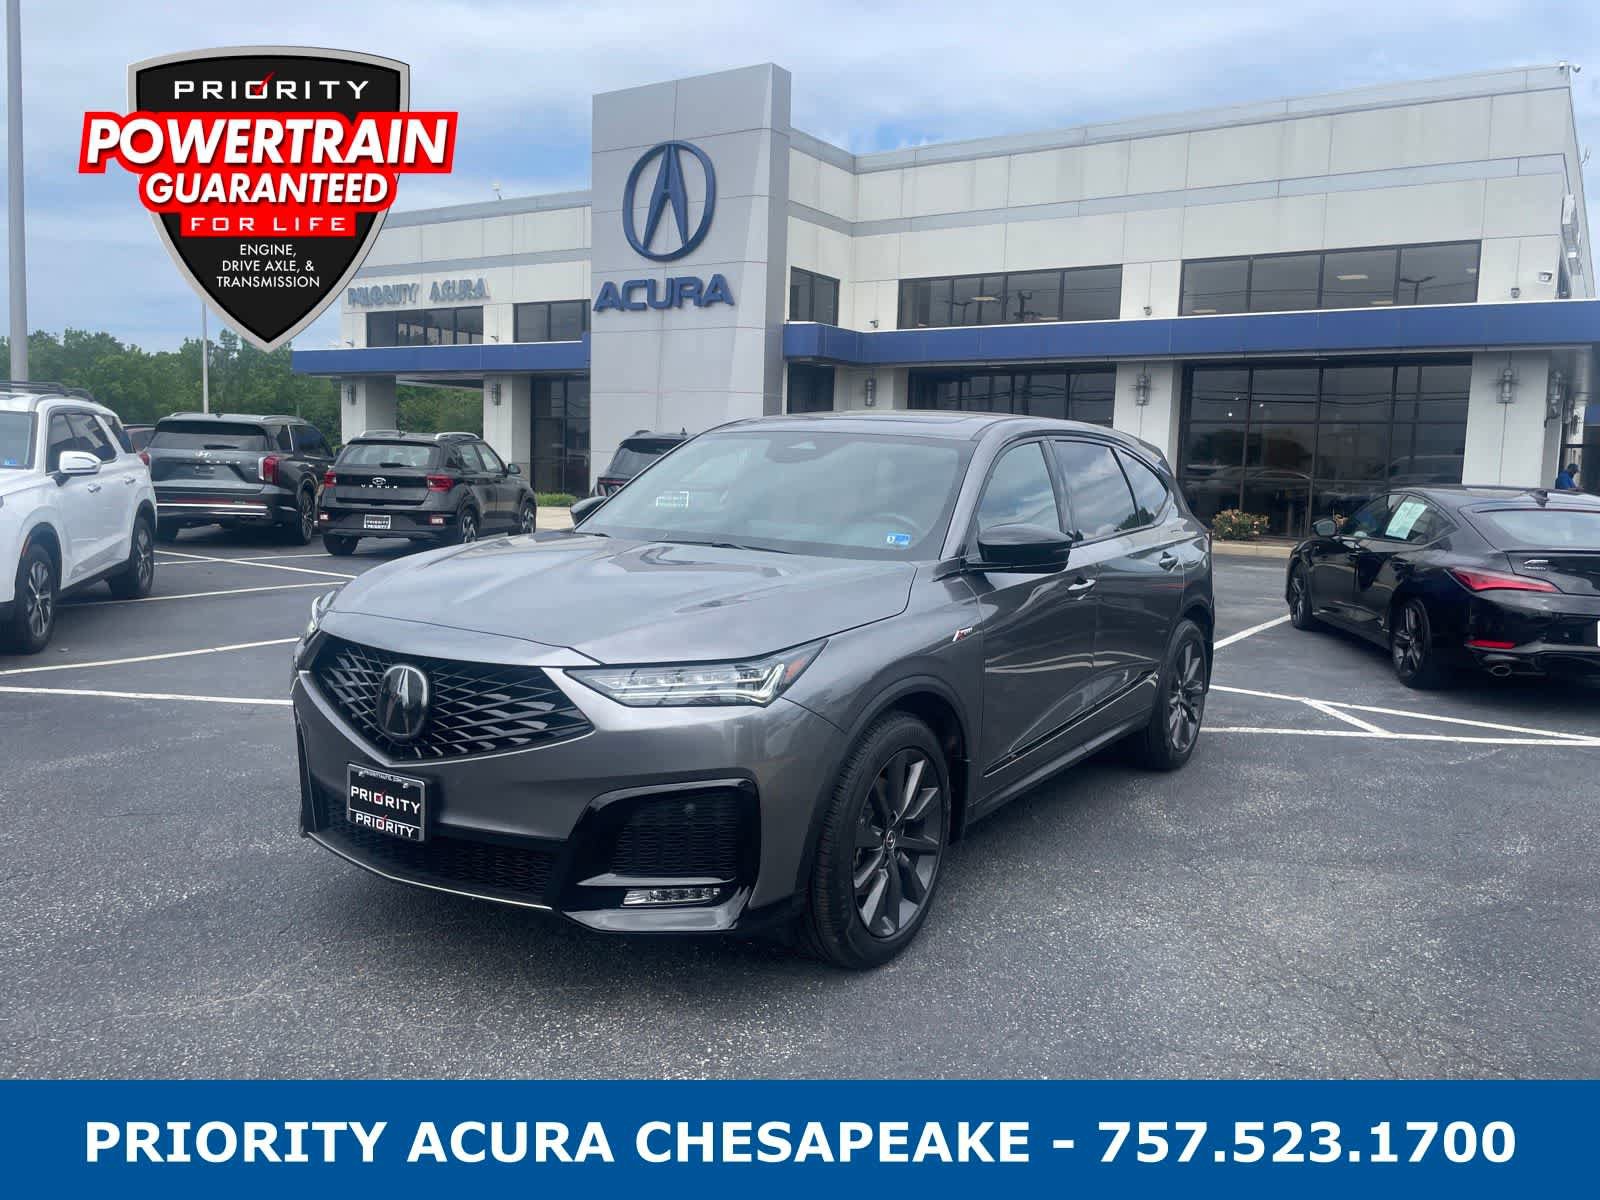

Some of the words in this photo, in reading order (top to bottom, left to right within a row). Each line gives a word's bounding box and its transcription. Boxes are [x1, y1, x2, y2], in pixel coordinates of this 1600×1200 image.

[347, 283, 419, 306] PRIORITY
[430, 278, 490, 302] ACURA
[593, 273, 735, 312] ACURA
[350, 785, 421, 814] PRIORITY
[355, 813, 414, 838] PRIORITY
